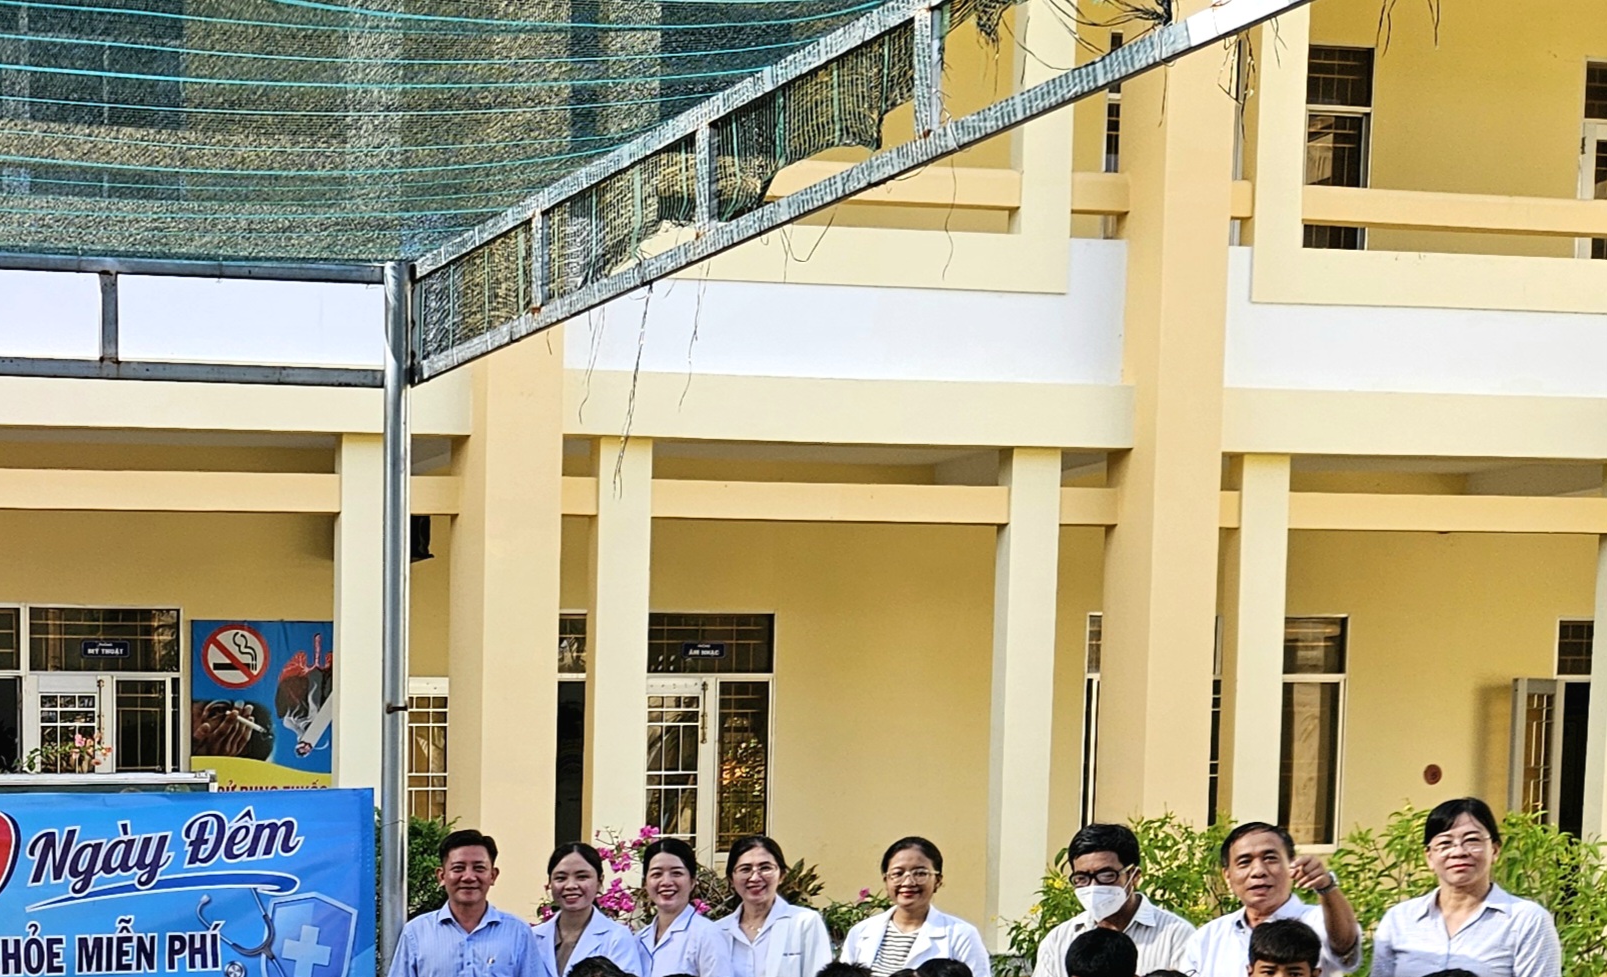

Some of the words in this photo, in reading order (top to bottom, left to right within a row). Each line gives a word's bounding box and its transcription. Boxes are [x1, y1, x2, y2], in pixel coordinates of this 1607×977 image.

[27, 820, 172, 895] Ngày
[183, 806, 305, 868] Đêm
[76, 916, 157, 975] MIỄN
[166, 921, 224, 972] PHÍ
